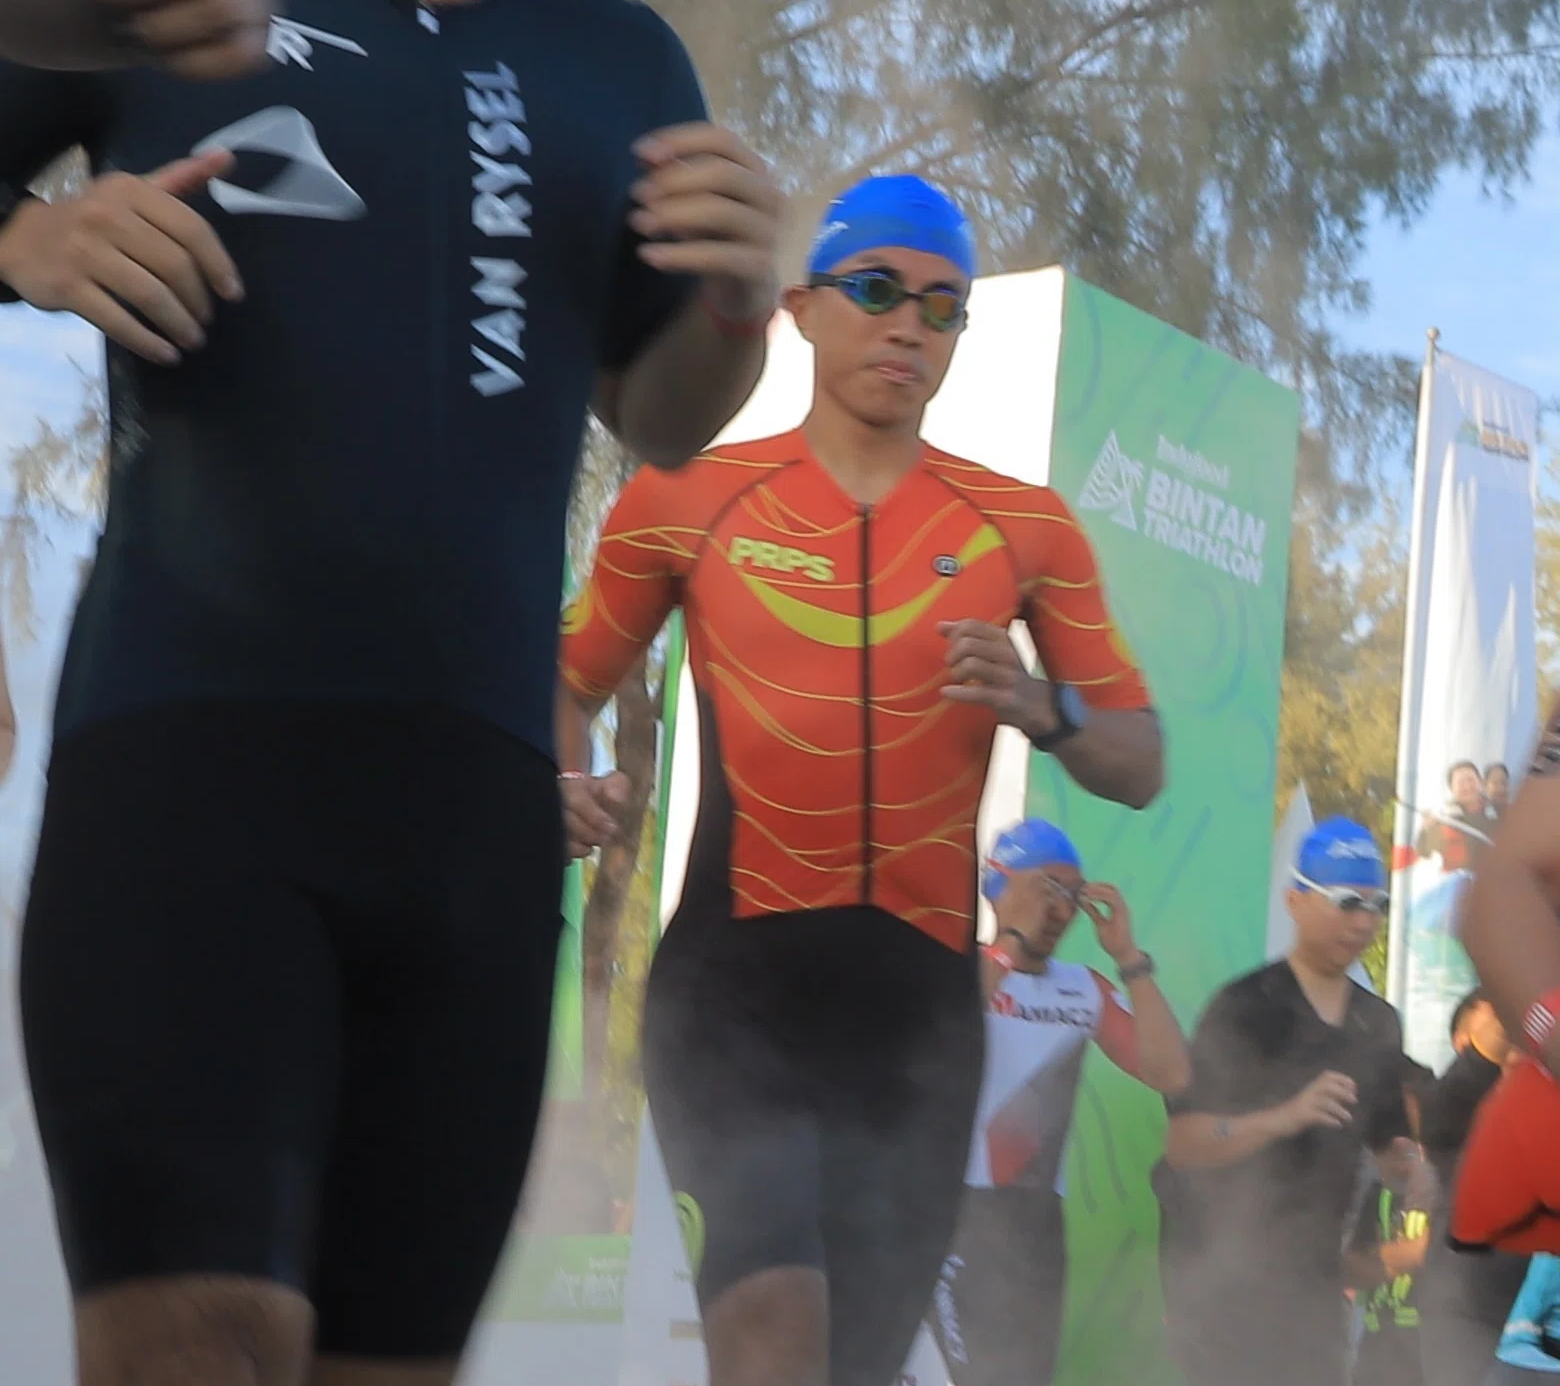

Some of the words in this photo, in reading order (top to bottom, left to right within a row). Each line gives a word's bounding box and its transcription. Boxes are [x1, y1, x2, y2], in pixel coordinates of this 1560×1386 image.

[462, 60, 533, 238] RYSEL
[469, 255, 528, 398] VAN
[1145, 510, 1262, 586] TRIATHLON
[1147, 470, 1265, 554] BINTAN
[729, 536, 835, 583] PRPS
